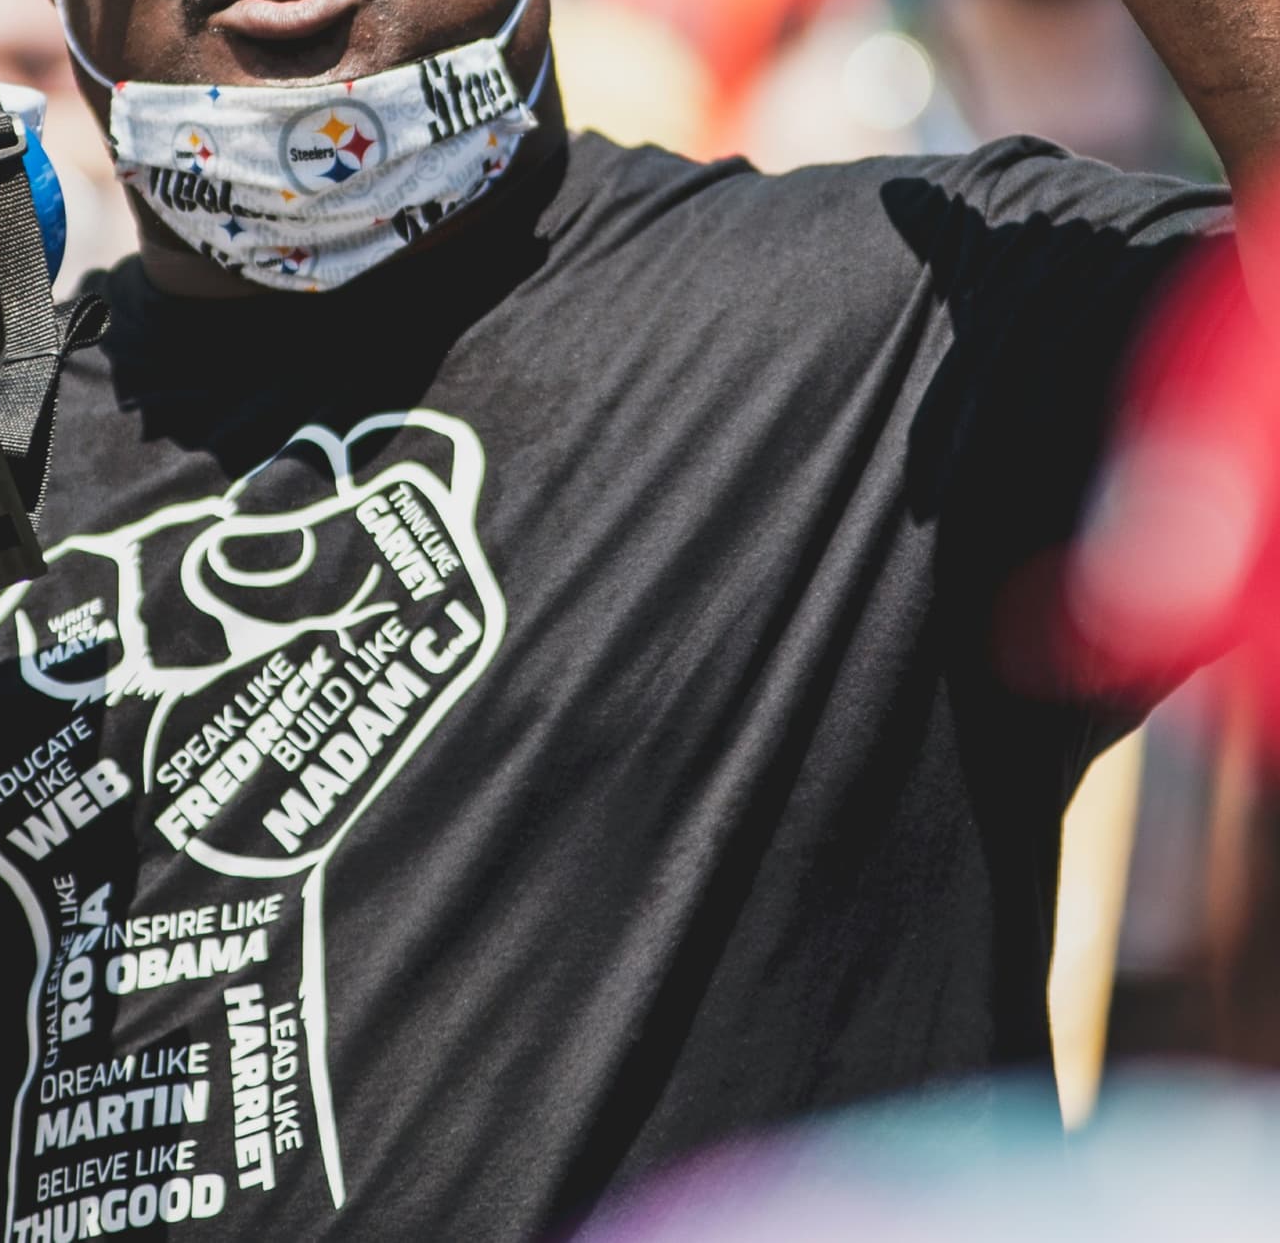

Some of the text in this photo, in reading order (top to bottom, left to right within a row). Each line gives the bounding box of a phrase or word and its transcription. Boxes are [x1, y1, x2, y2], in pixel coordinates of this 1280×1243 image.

[289, 146, 335, 162] Steelers
[356, 494, 446, 602] GARVEY
[389, 482, 460, 578] THINK LIKE
[39, 618, 117, 671] MAYA
[47, 596, 104, 633] WRITE
[58, 615, 96, 644] LIKE
[156, 651, 297, 793] SPEAK LIKE
[270, 616, 412, 772] BUILD LIKE
[22, 757, 77, 808] LIKE
[154, 644, 335, 851] FREDRICK
[261, 660, 430, 854] MADAM
[5, 758, 132, 862] WEB
[61, 881, 111, 1042] ROSA
[104, 893, 284, 950] INSPIRE LIKE
[105, 928, 269, 995] OBAMA
[43, 873, 78, 1069] CHALLENGE LIKE
[39, 1042, 210, 1105] DREAM LIKE
[223, 983, 276, 1191] HARRIET
[269, 1002, 303, 1155] LEAD LIKE
[33, 1079, 210, 1157] MARTIN
[13, 1173, 226, 1243] THURGOOD
[36, 1139, 199, 1202] BELIEVE LIKE
